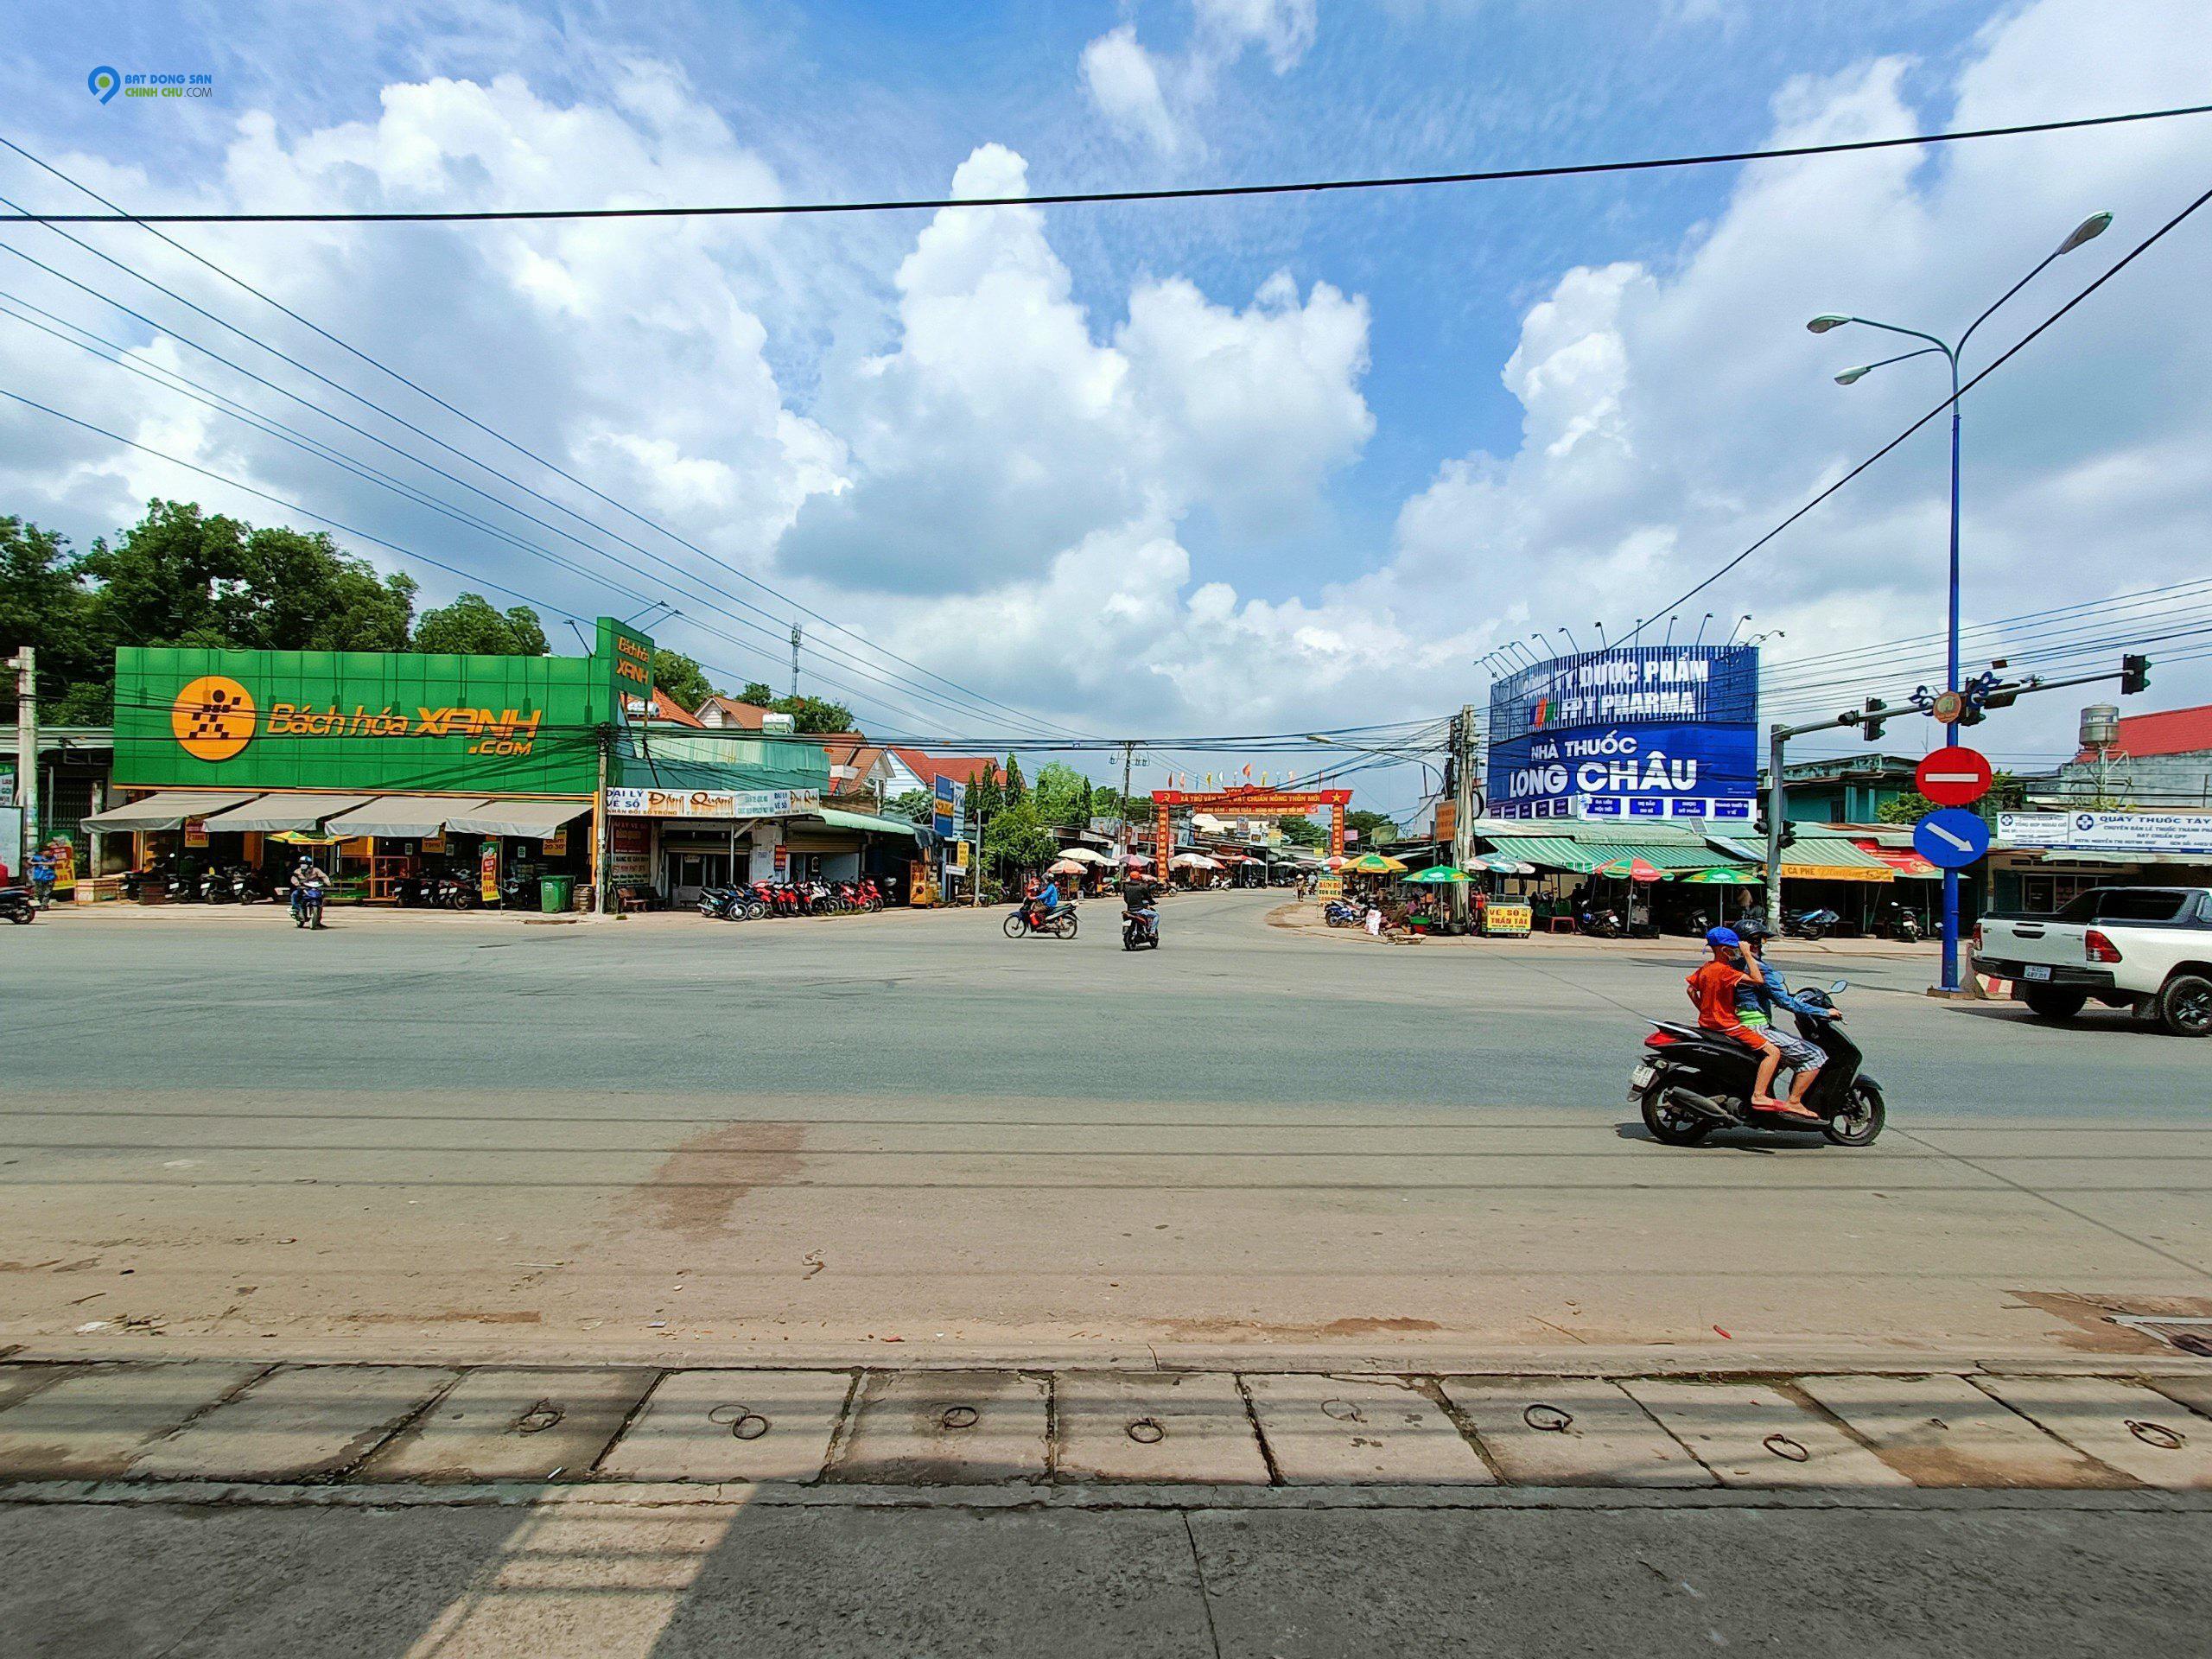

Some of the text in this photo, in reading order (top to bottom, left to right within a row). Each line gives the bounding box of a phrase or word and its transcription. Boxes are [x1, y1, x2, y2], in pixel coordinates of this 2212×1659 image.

[616, 658, 649, 685] XANH
[1600, 692, 1696, 716] PHARMA
[267, 703, 542, 740] Bách hóa XANH
[1531, 729, 1637, 760] NHÀ THUỐC
[1510, 750, 1698, 798] LONG CHÂU
